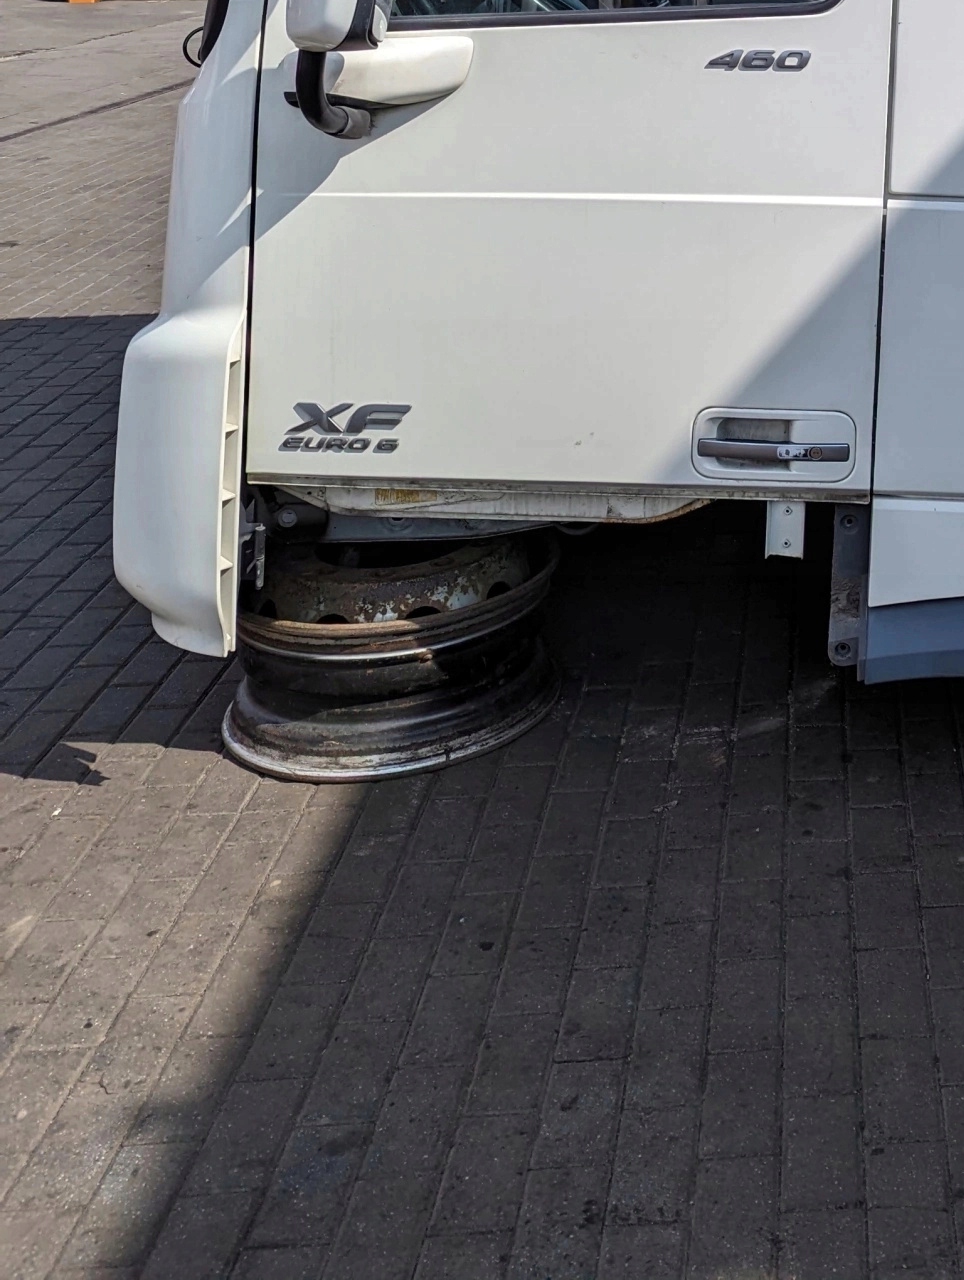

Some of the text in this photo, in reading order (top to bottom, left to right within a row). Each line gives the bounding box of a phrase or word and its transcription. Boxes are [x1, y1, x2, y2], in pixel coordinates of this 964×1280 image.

[704, 48, 812, 72] 460
[284, 402, 412, 436] XF
[278, 436, 400, 453] EURO 6
